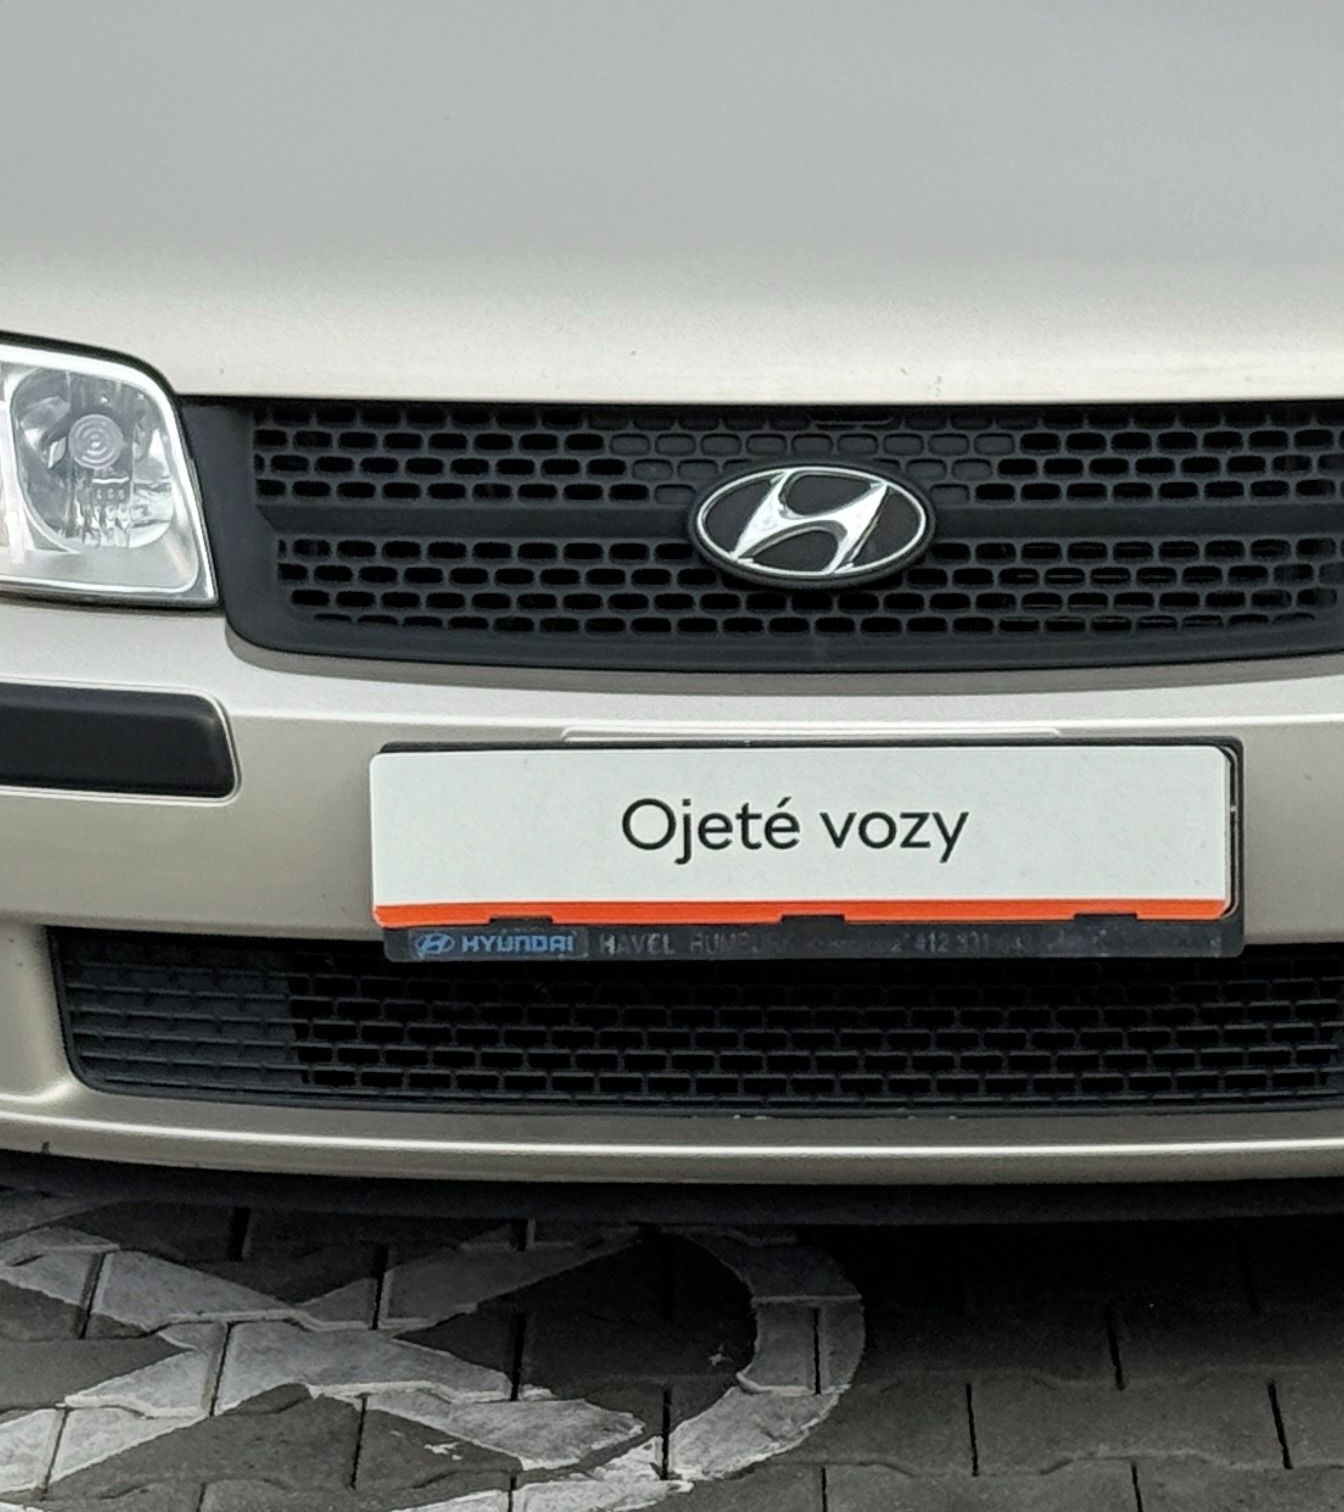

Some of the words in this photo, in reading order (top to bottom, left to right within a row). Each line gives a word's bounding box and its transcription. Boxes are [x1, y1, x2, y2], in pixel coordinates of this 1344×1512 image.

[622, 796, 801, 865] Ojeté
[819, 811, 969, 864] vozy
[461, 935, 576, 953] HYUNDAI
